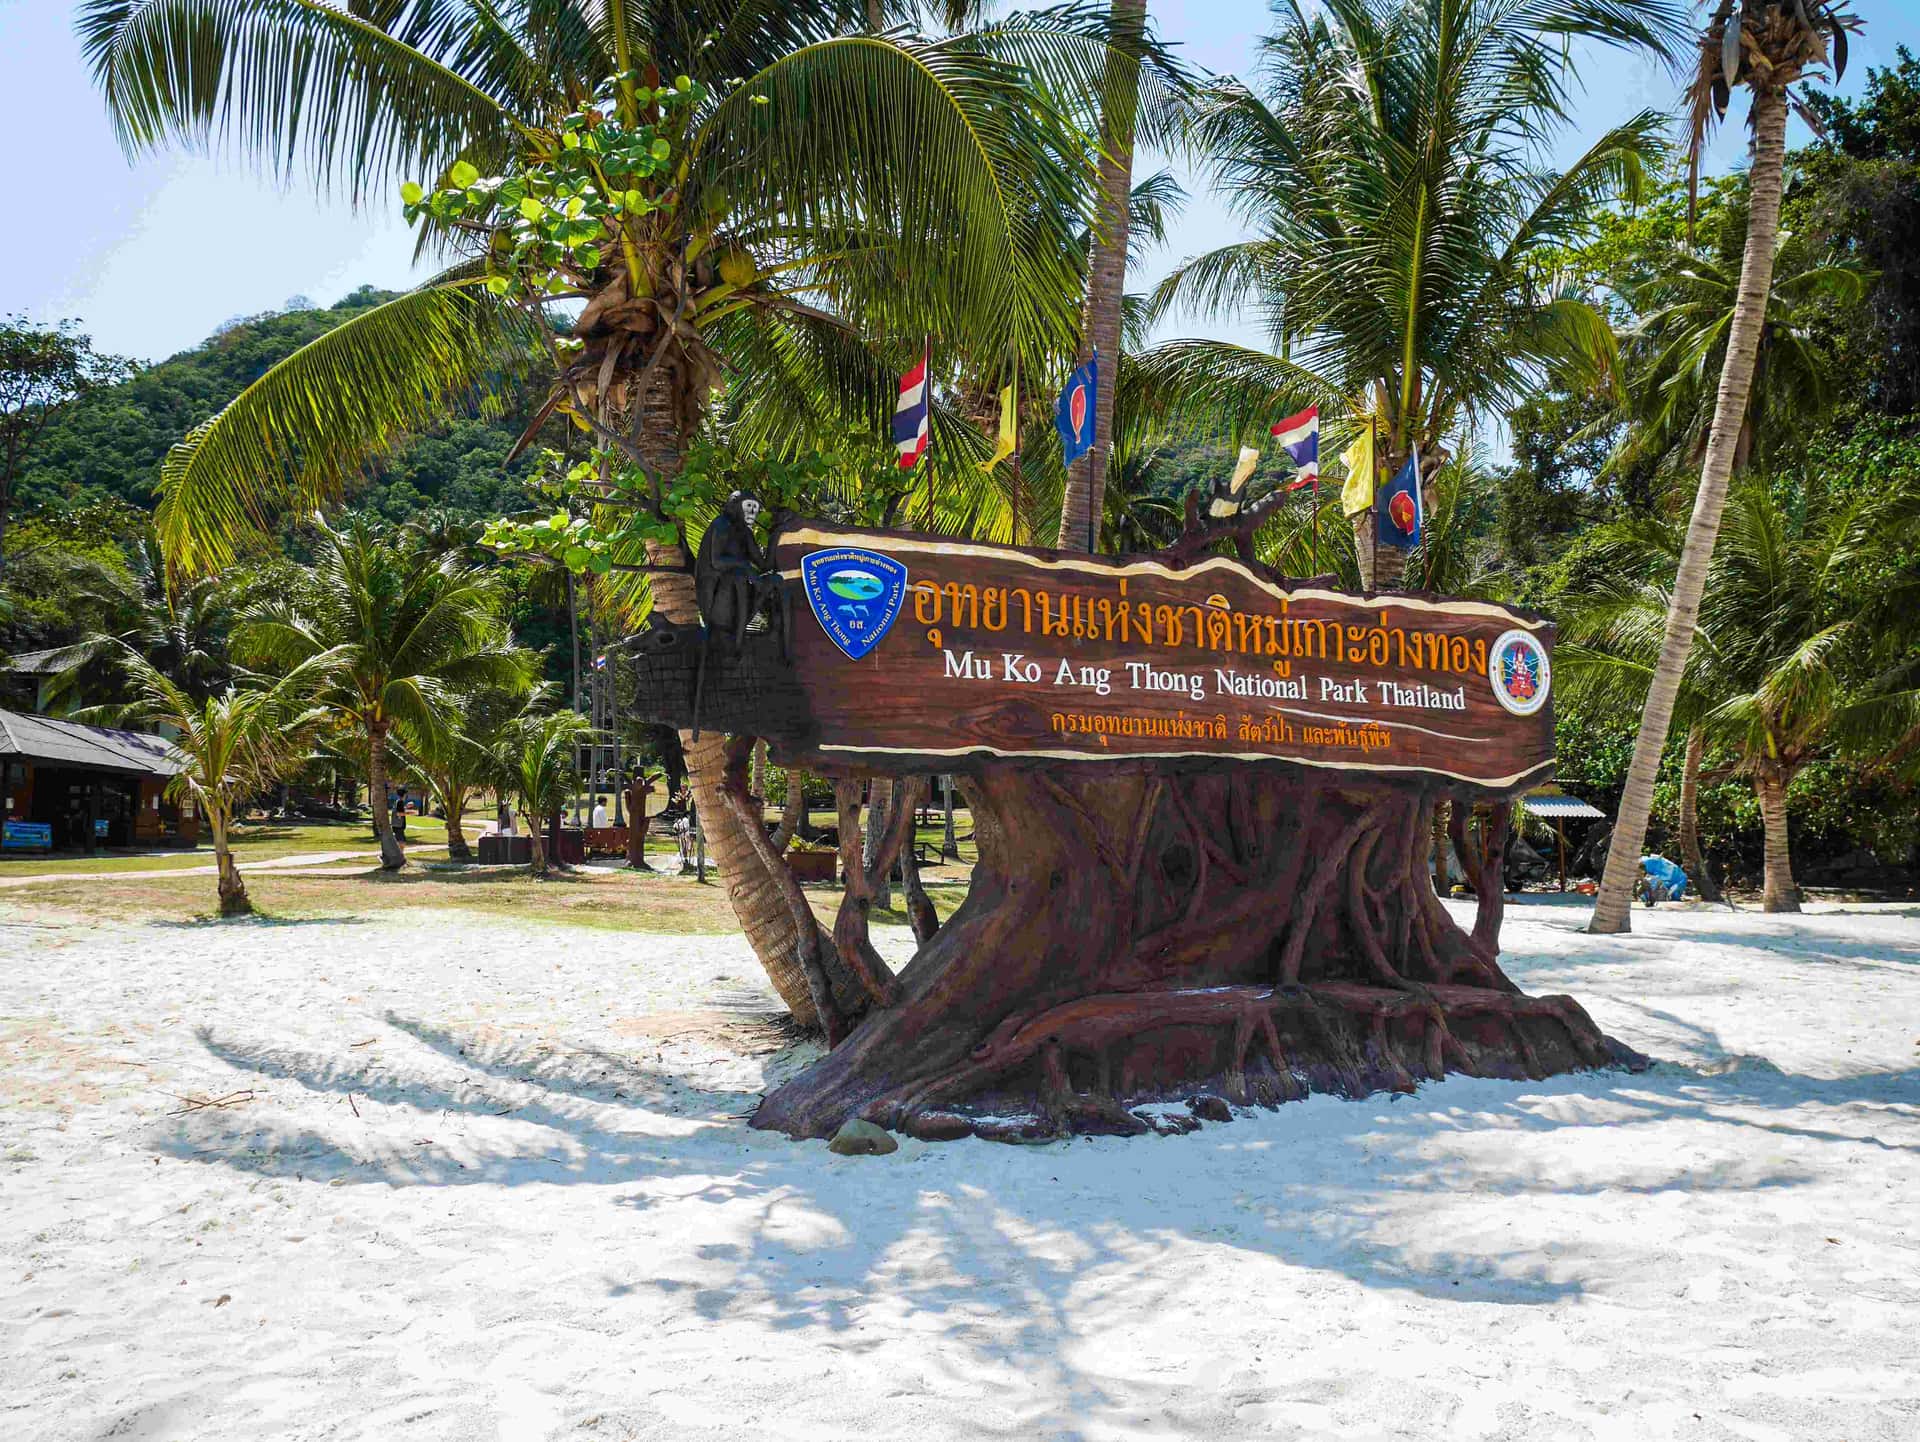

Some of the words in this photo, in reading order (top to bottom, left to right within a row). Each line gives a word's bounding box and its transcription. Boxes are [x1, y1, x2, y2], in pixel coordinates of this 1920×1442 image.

[808, 570, 817, 586] Mu
[813, 587, 822, 601] Ko
[818, 603, 832, 621] Ang
[830, 621, 851, 646] Thong
[861, 608, 893, 647] National
[888, 581, 900, 607] Park
[913, 578, 1487, 677] อุทยานแห่งชาติหมู่เกาะอ่างทอง
[943, 650, 993, 679] Mu
[1001, 653, 1042, 682] Ko
[1053, 658, 1111, 695] Ang
[1125, 662, 1205, 701] Thong
[1214, 669, 1308, 700] National
[1318, 677, 1368, 704] Park
[1377, 681, 1467, 710] Thailand
[1052, 710, 1228, 746] กรมอุทยานแห่งชาติ
[1238, 711, 1293, 744] สัตว์ป่า
